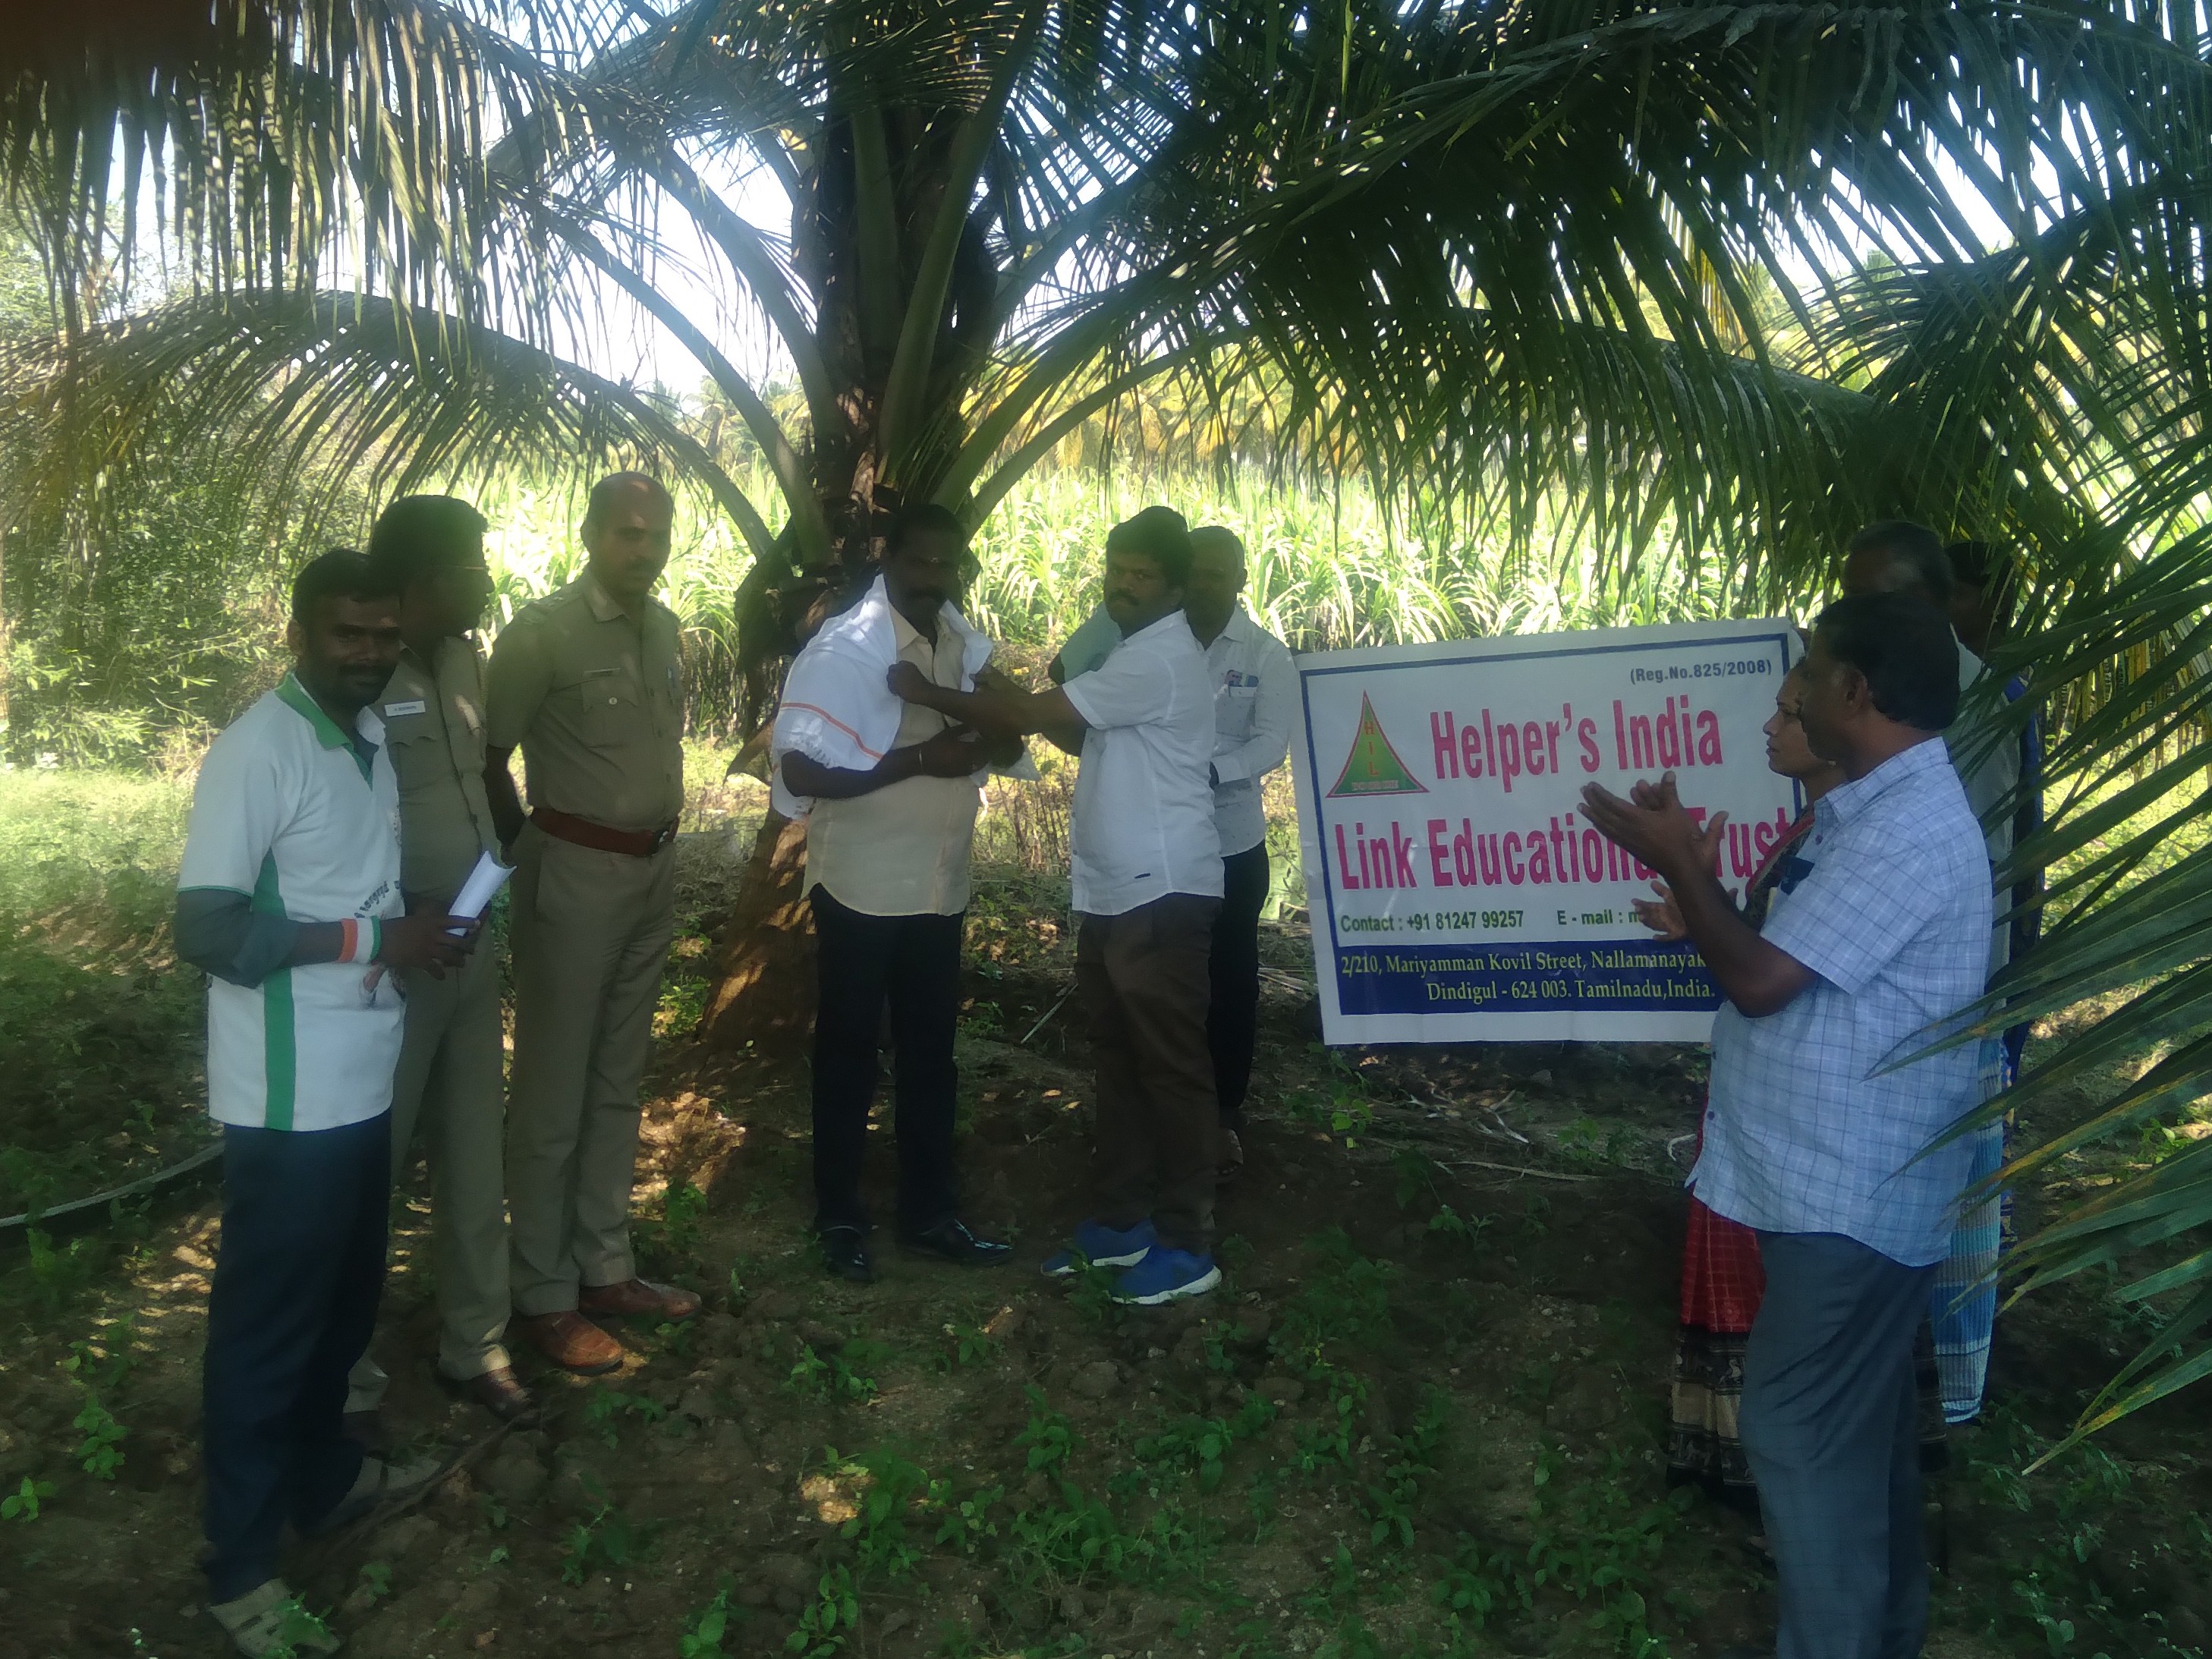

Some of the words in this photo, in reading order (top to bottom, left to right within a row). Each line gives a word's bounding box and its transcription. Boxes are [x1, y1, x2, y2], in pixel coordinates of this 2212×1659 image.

[1630, 660, 1772, 685] (Reg.No.825/2008)
[1613, 694, 1723, 770] India
[1335, 821, 1417, 889] Link
[1341, 914, 1395, 932] Contact
[1407, 913, 1430, 931] +91
[1436, 911, 1477, 930] 81247
[1481, 910, 1524, 928] 99257
[1581, 909, 1613, 924] mail
[1342, 955, 1383, 977] 2/210,
[1386, 955, 1485, 978] Mariyamman
[1488, 952, 1532, 970] Kovil
[1536, 952, 1587, 971] Street,
[1427, 981, 1497, 1005] Dindigul
[1512, 981, 1537, 998] 624
[1541, 980, 1572, 998] 003.
